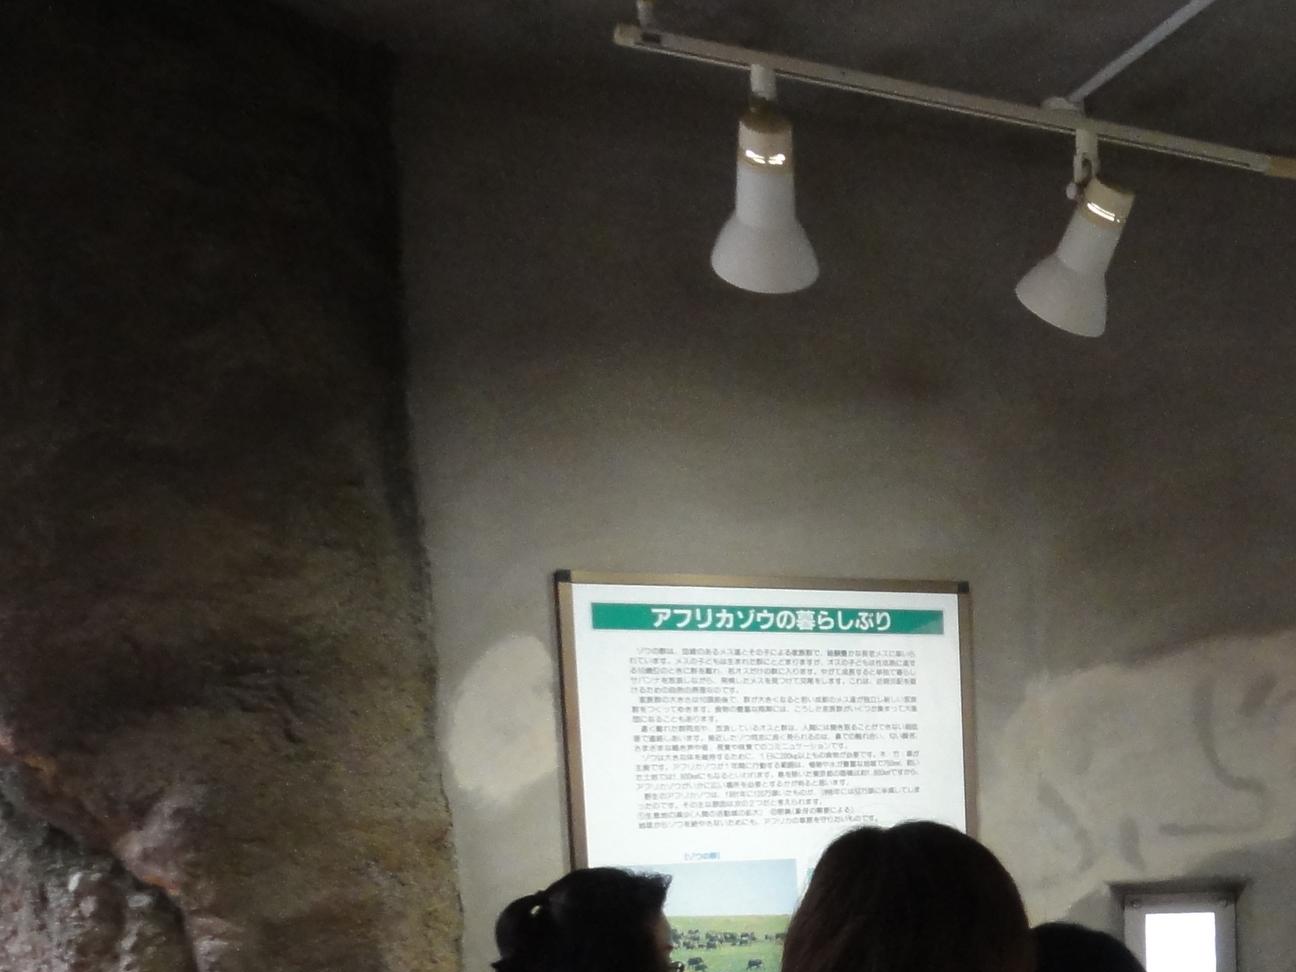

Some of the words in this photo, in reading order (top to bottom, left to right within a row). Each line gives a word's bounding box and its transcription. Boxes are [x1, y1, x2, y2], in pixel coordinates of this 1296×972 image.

[650, 607, 892, 631] アフリカゾウの暮らしぶり
